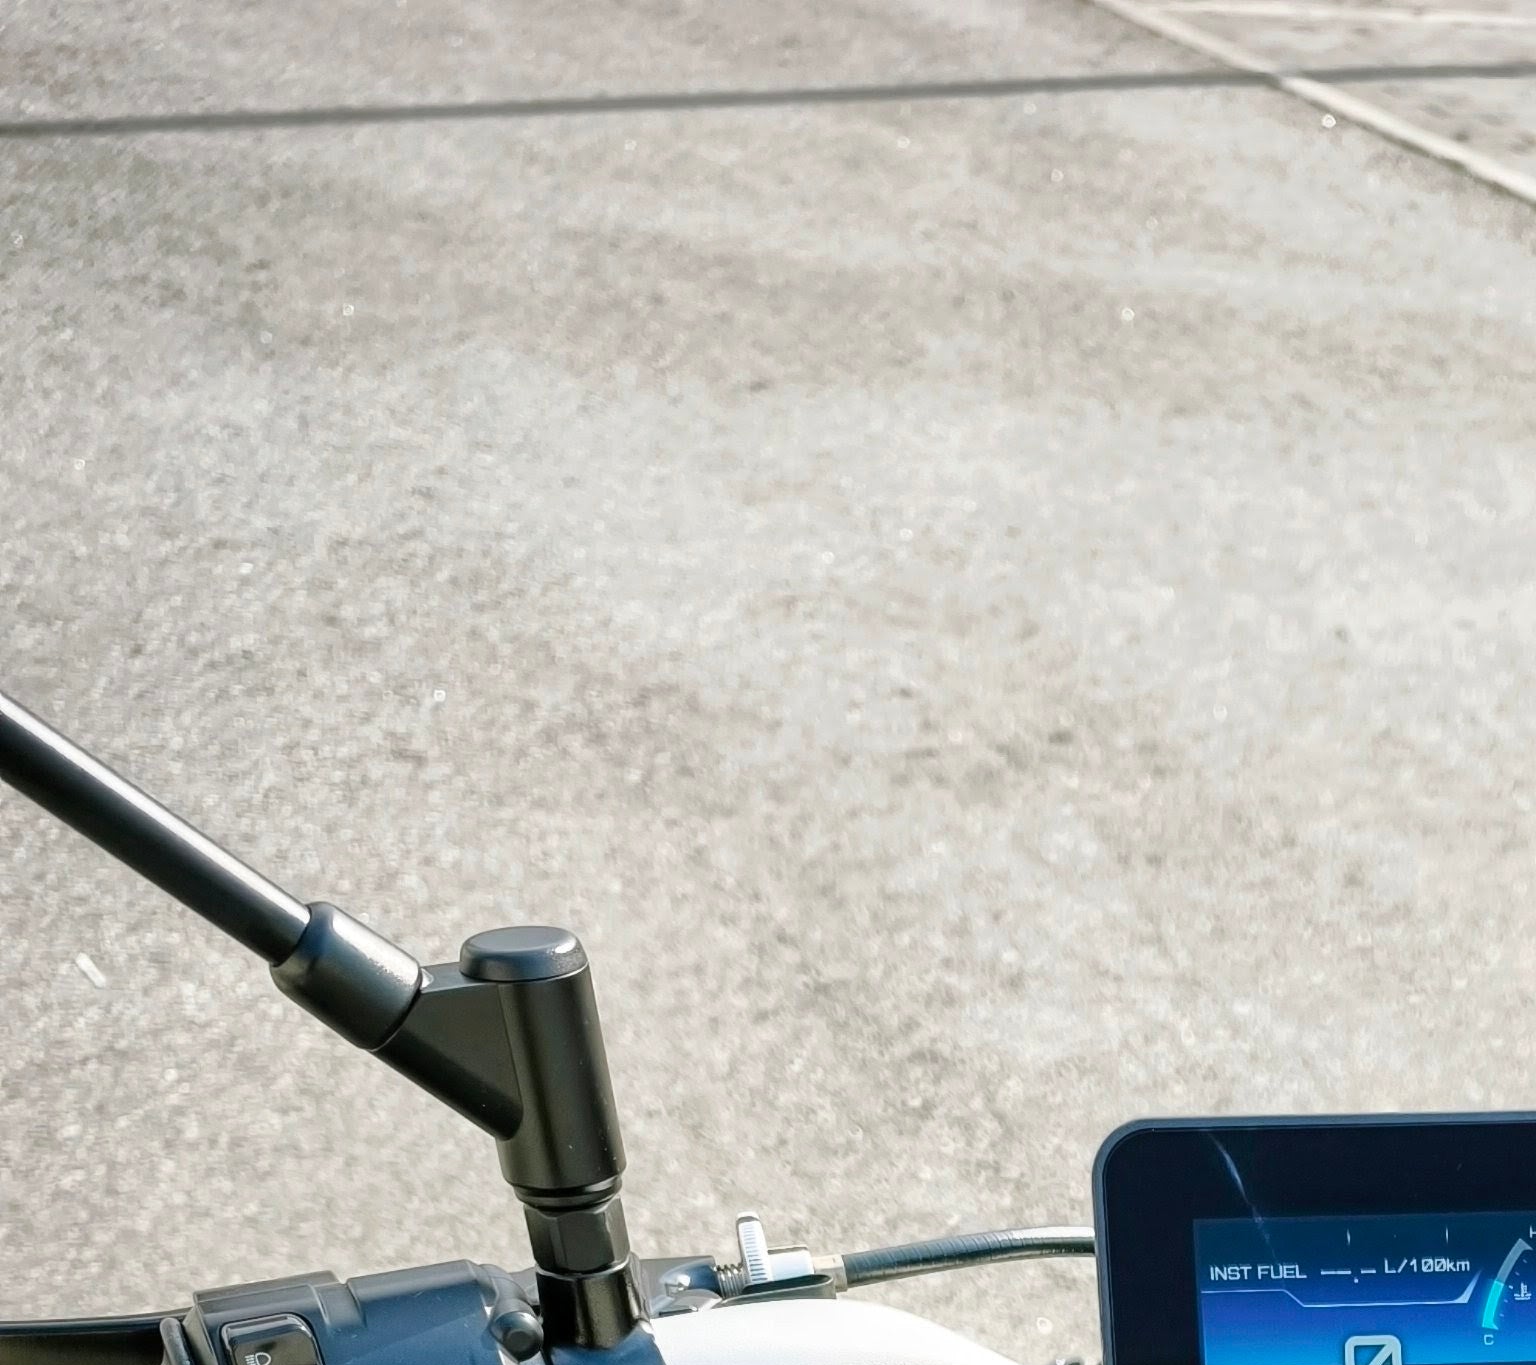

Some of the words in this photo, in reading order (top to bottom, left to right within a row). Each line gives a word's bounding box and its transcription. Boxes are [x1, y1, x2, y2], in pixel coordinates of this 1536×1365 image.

[1210, 1265, 1251, 1281] INST
[1258, 1264, 1307, 1280] FUEL
[1384, 1257, 1470, 1275] L/100km
[1483, 1334, 1494, 1346] C
